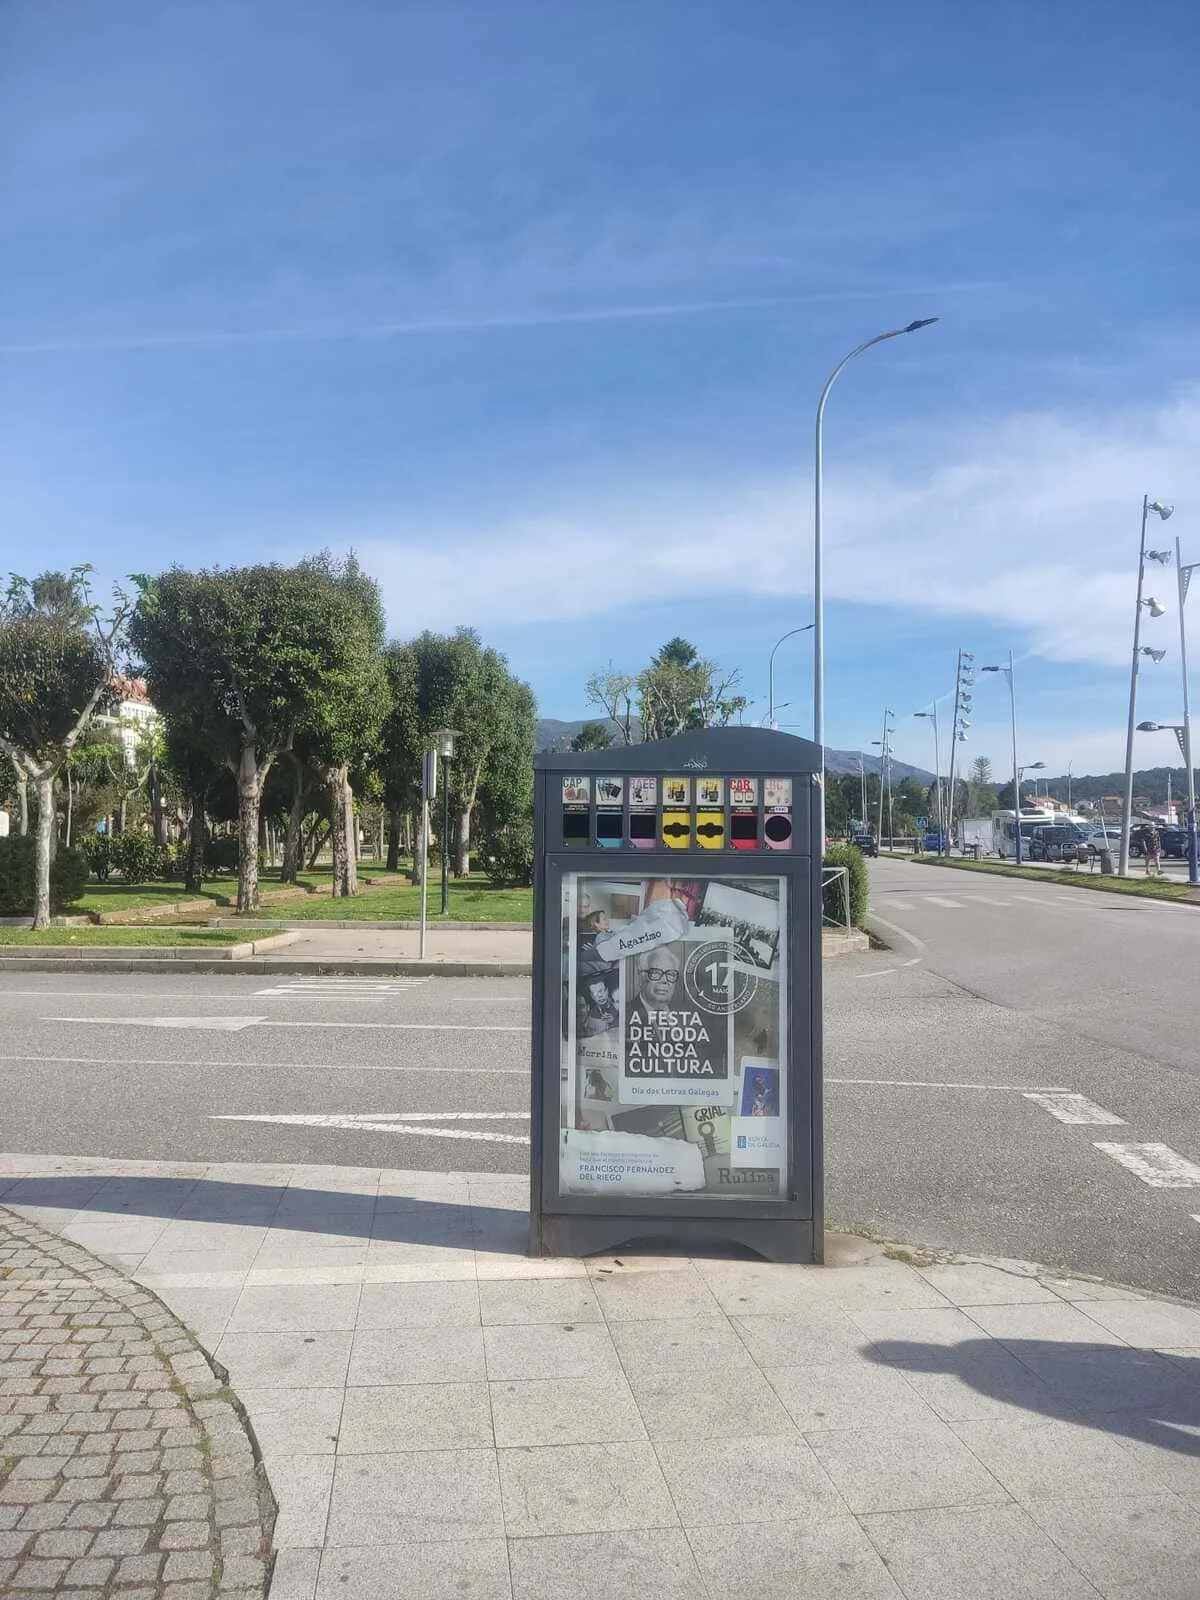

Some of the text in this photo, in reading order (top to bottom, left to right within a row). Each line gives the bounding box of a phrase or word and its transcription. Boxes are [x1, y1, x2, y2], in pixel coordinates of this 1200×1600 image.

[618, 930, 662, 950] Agarimo
[705, 962, 733, 986] 17
[629, 1011, 703, 1026] A FESTA
[630, 1026, 710, 1042] DE TODA
[629, 1043, 698, 1058] A NOSA
[629, 1059, 714, 1074] CULTURA
[646, 1087, 659, 1095] das
[661, 1088, 686, 1096] Letras
[688, 1088, 720, 1098] Galegas
[694, 1105, 727, 1122] GRIAL
[579, 1165, 625, 1173] FRANCISCO
[597, 1174, 622, 1182] RIEGO
